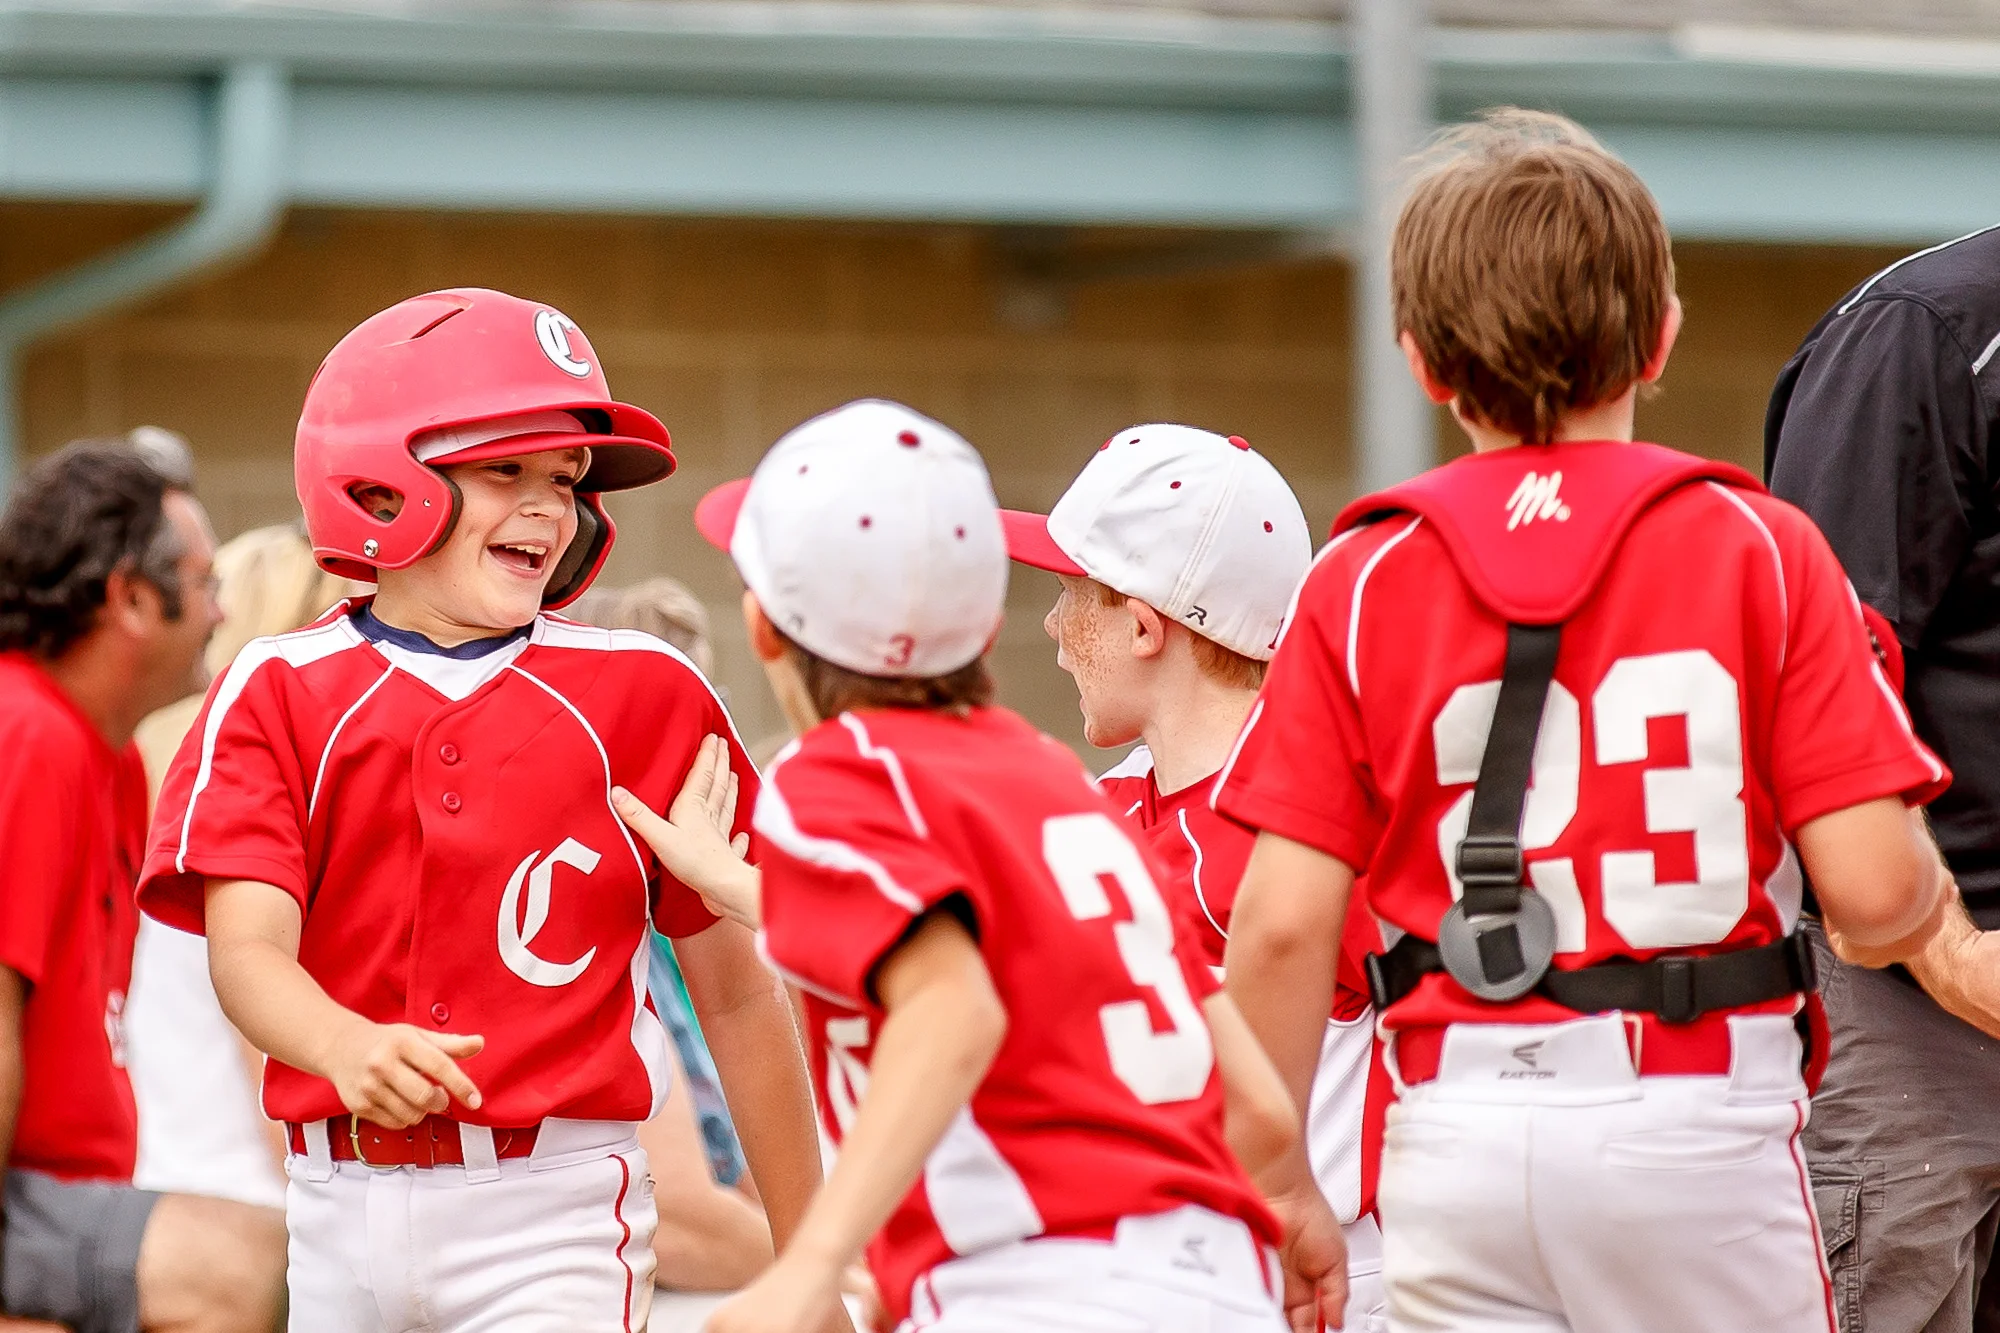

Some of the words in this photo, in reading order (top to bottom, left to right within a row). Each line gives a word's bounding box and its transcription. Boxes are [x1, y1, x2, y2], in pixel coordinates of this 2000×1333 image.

[535, 309, 593, 378] C
[883, 634, 917, 668] 3
[1187, 605, 1207, 626] R
[1433, 650, 1750, 953] 23
[498, 837, 602, 987] C
[1043, 814, 1214, 1105] 3
